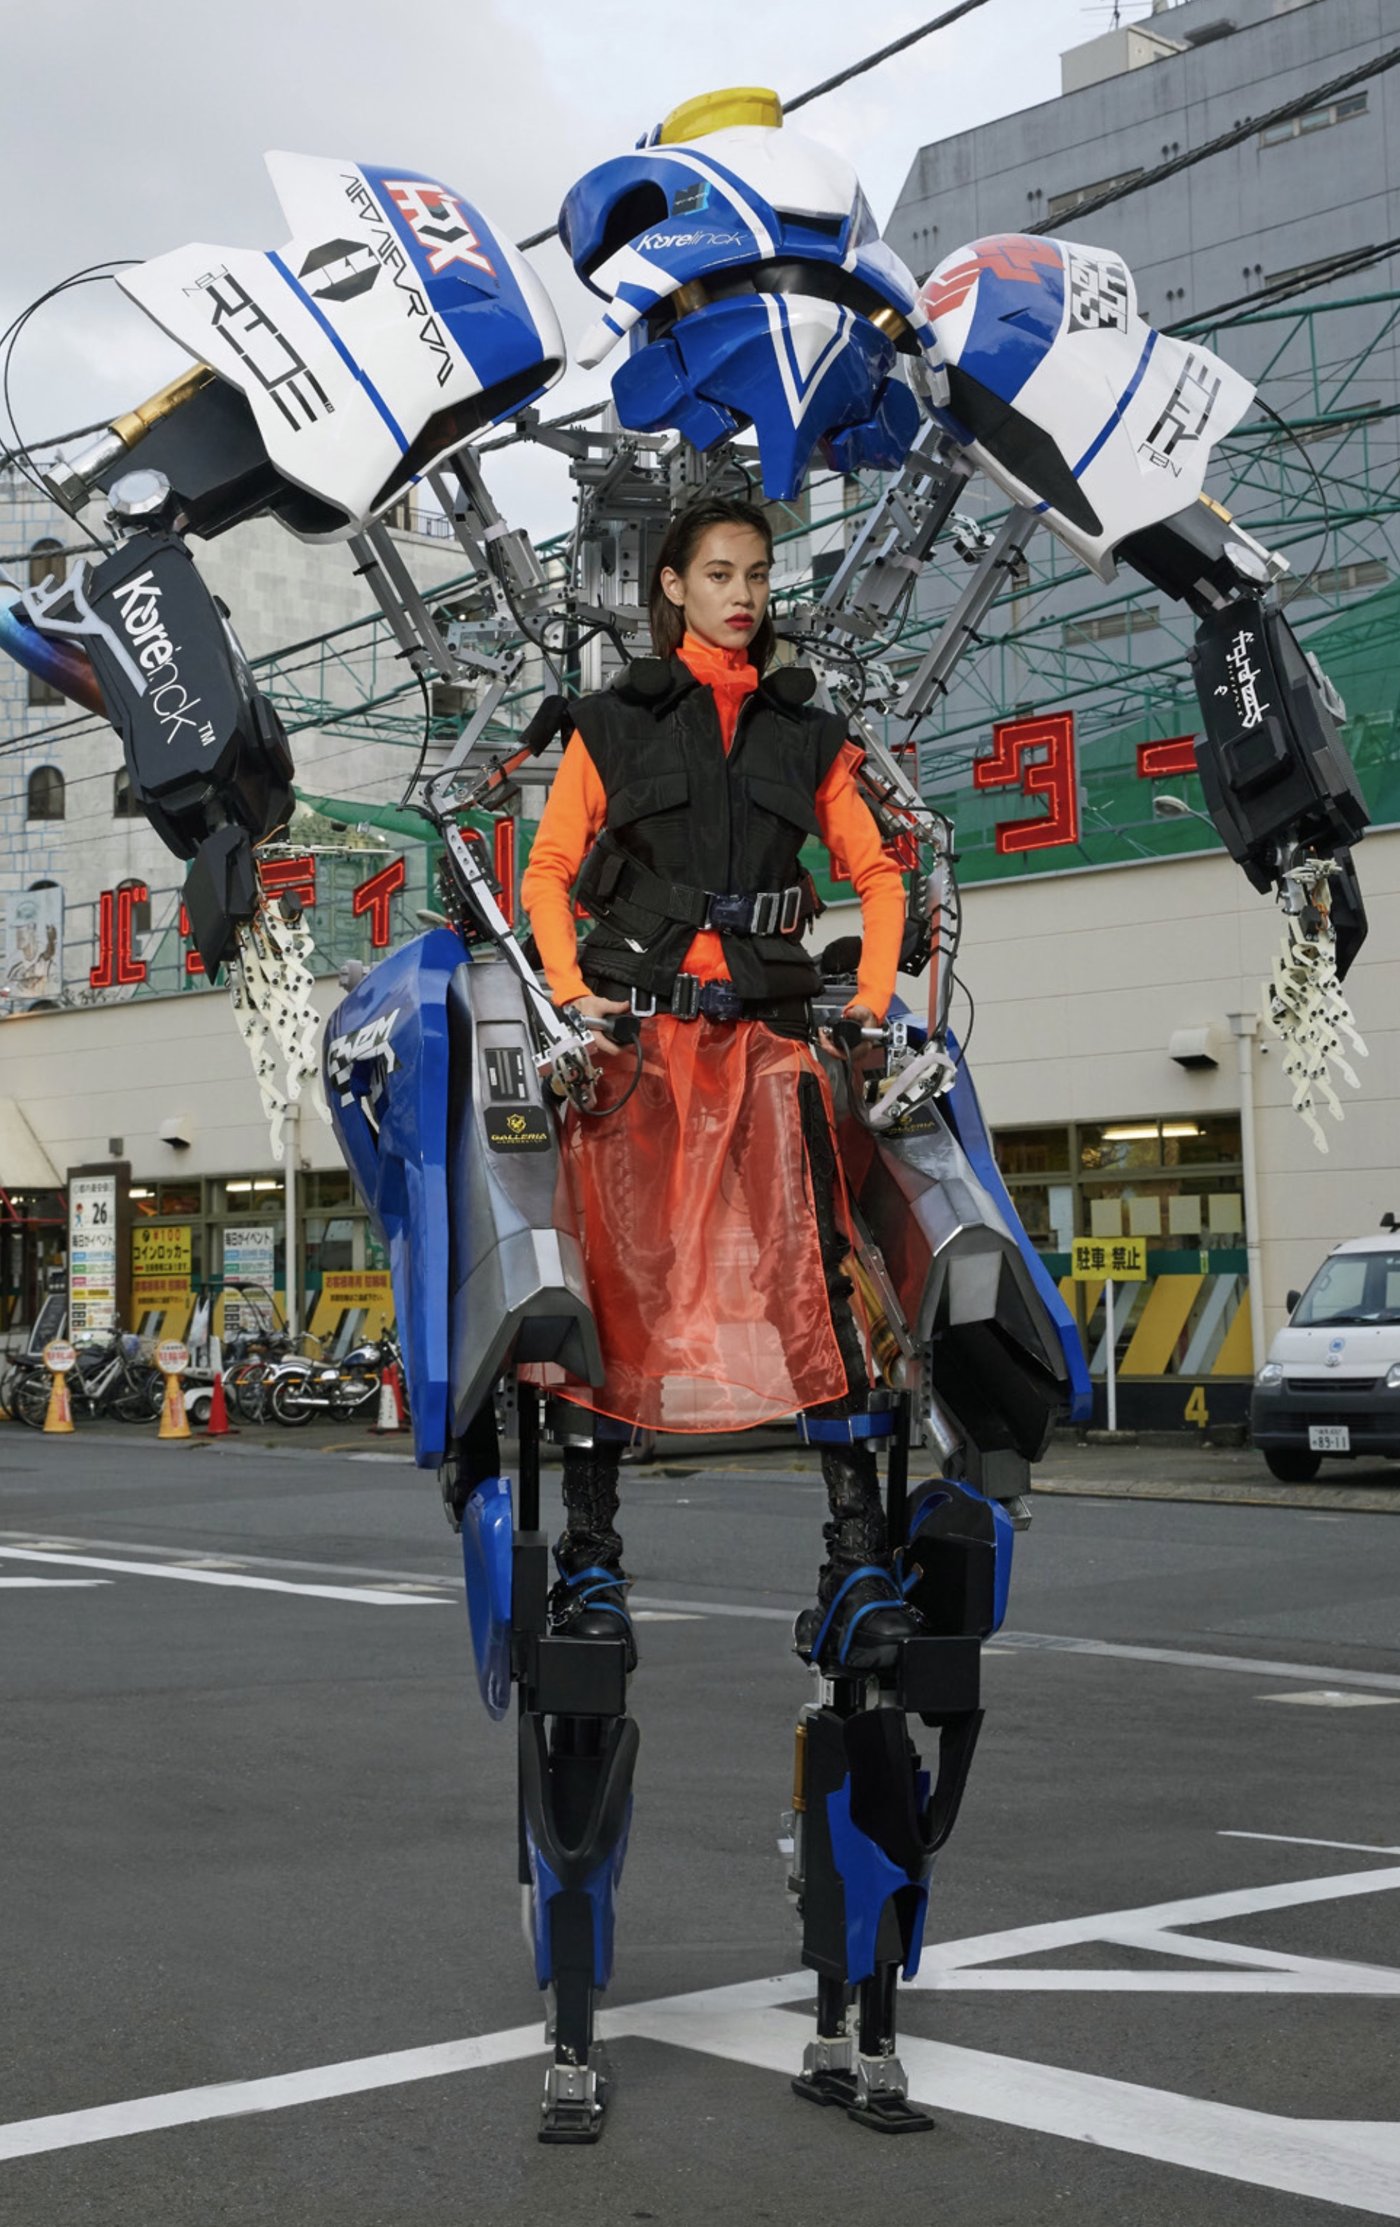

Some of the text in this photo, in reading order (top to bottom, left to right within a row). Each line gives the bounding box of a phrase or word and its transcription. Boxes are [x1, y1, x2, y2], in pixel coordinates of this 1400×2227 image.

[92, 1202, 107, 1225] 26
[133, 1246, 190, 1260] コインロッカー
[1076, 1246, 1141, 1272] 駐車 禁止
[1184, 1386, 1209, 1428] 4
